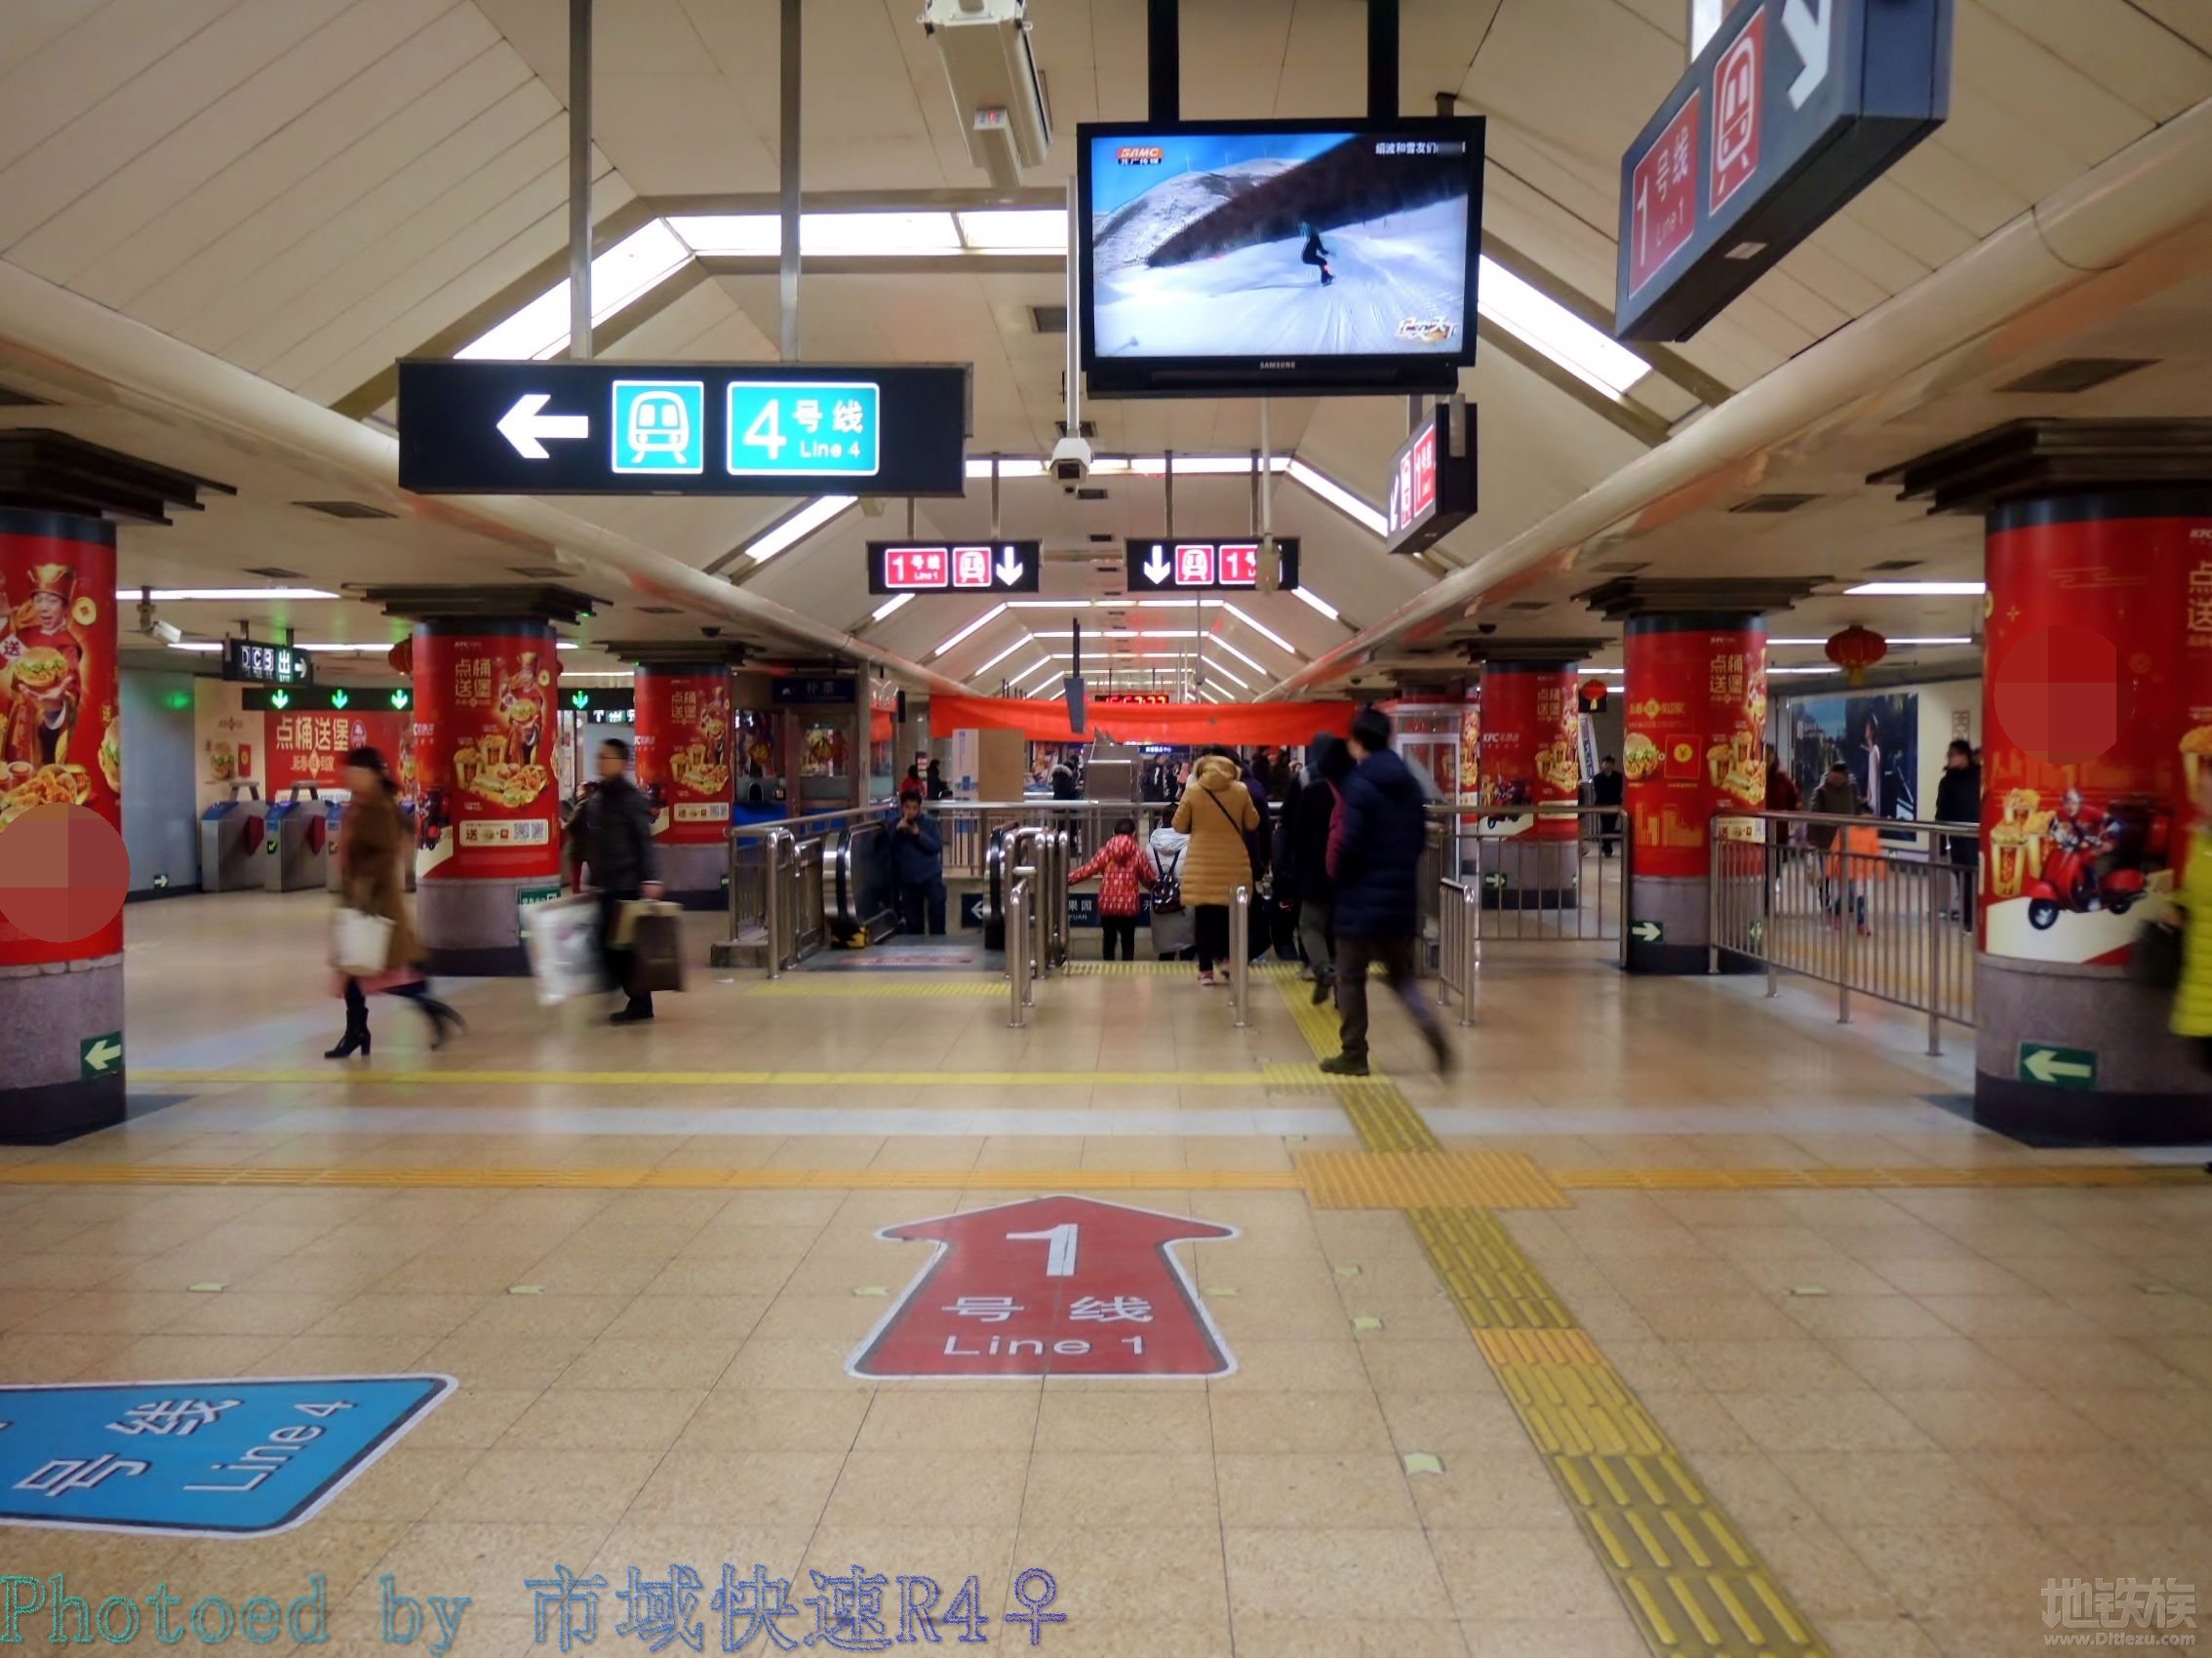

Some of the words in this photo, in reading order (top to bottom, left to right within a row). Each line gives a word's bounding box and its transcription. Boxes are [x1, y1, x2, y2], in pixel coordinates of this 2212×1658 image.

[1637, 174, 1648, 267] 1
[1655, 125, 1689, 203] 号线
[1656, 208, 1678, 248] Line
[1678, 198, 1684, 234] 1
[743, 398, 787, 459] 4
[792, 398, 864, 434] 号线
[800, 439, 843, 458] Line
[847, 439, 861, 458] 4
[891, 555, 904, 581] 1
[1226, 551, 1239, 578] 1
[3, 640, 20, 658] 送
[278, 650, 291, 674] 出
[454, 657, 492, 679] 点桶
[1710, 654, 1743, 673] 点桶
[454, 679, 492, 699] 送堡
[1710, 674, 1743, 694] 送堡
[276, 715, 349, 752] 点桶送堡
[1006, 1223, 1079, 1277] 1
[941, 1295, 1153, 1322] 号线
[944, 1335, 1092, 1356] Line
[1122, 1335, 1144, 1356] 1
[12, 1397, 245, 1497] 号线
[182, 1423, 328, 1493] Line
[294, 1399, 359, 1418] 4
